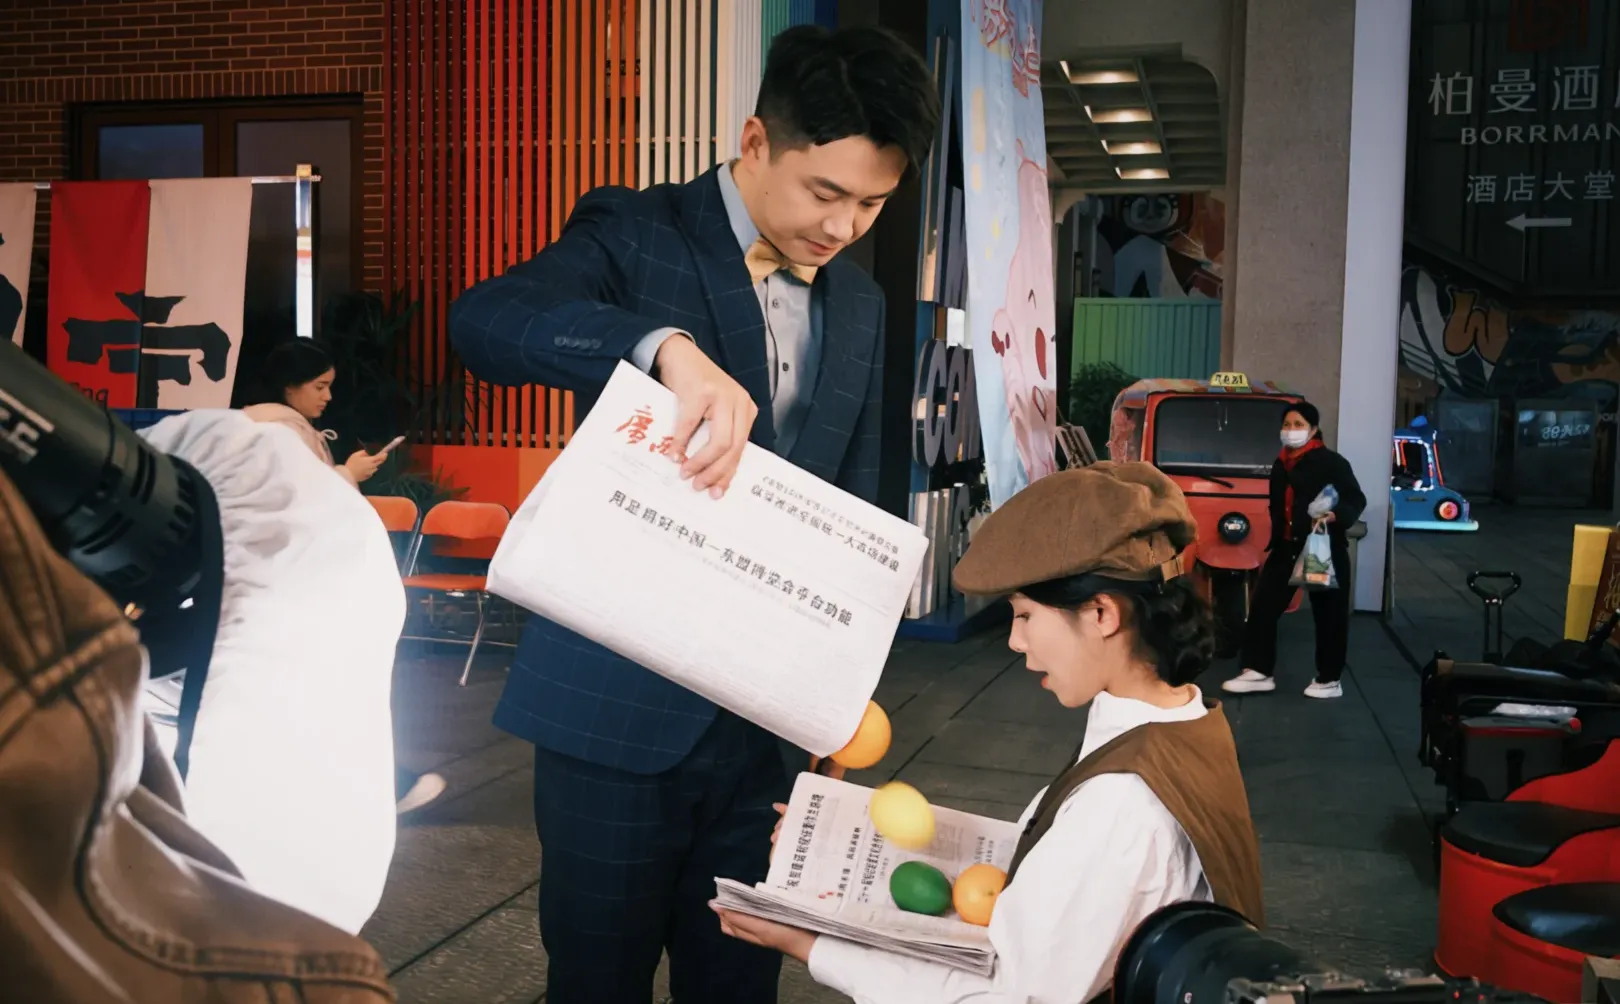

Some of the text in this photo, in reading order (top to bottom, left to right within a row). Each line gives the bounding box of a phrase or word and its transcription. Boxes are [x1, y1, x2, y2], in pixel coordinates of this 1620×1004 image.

[1428, 65, 1620, 115] 柏曼酒
[1467, 170, 1615, 203] 酒店大堂
